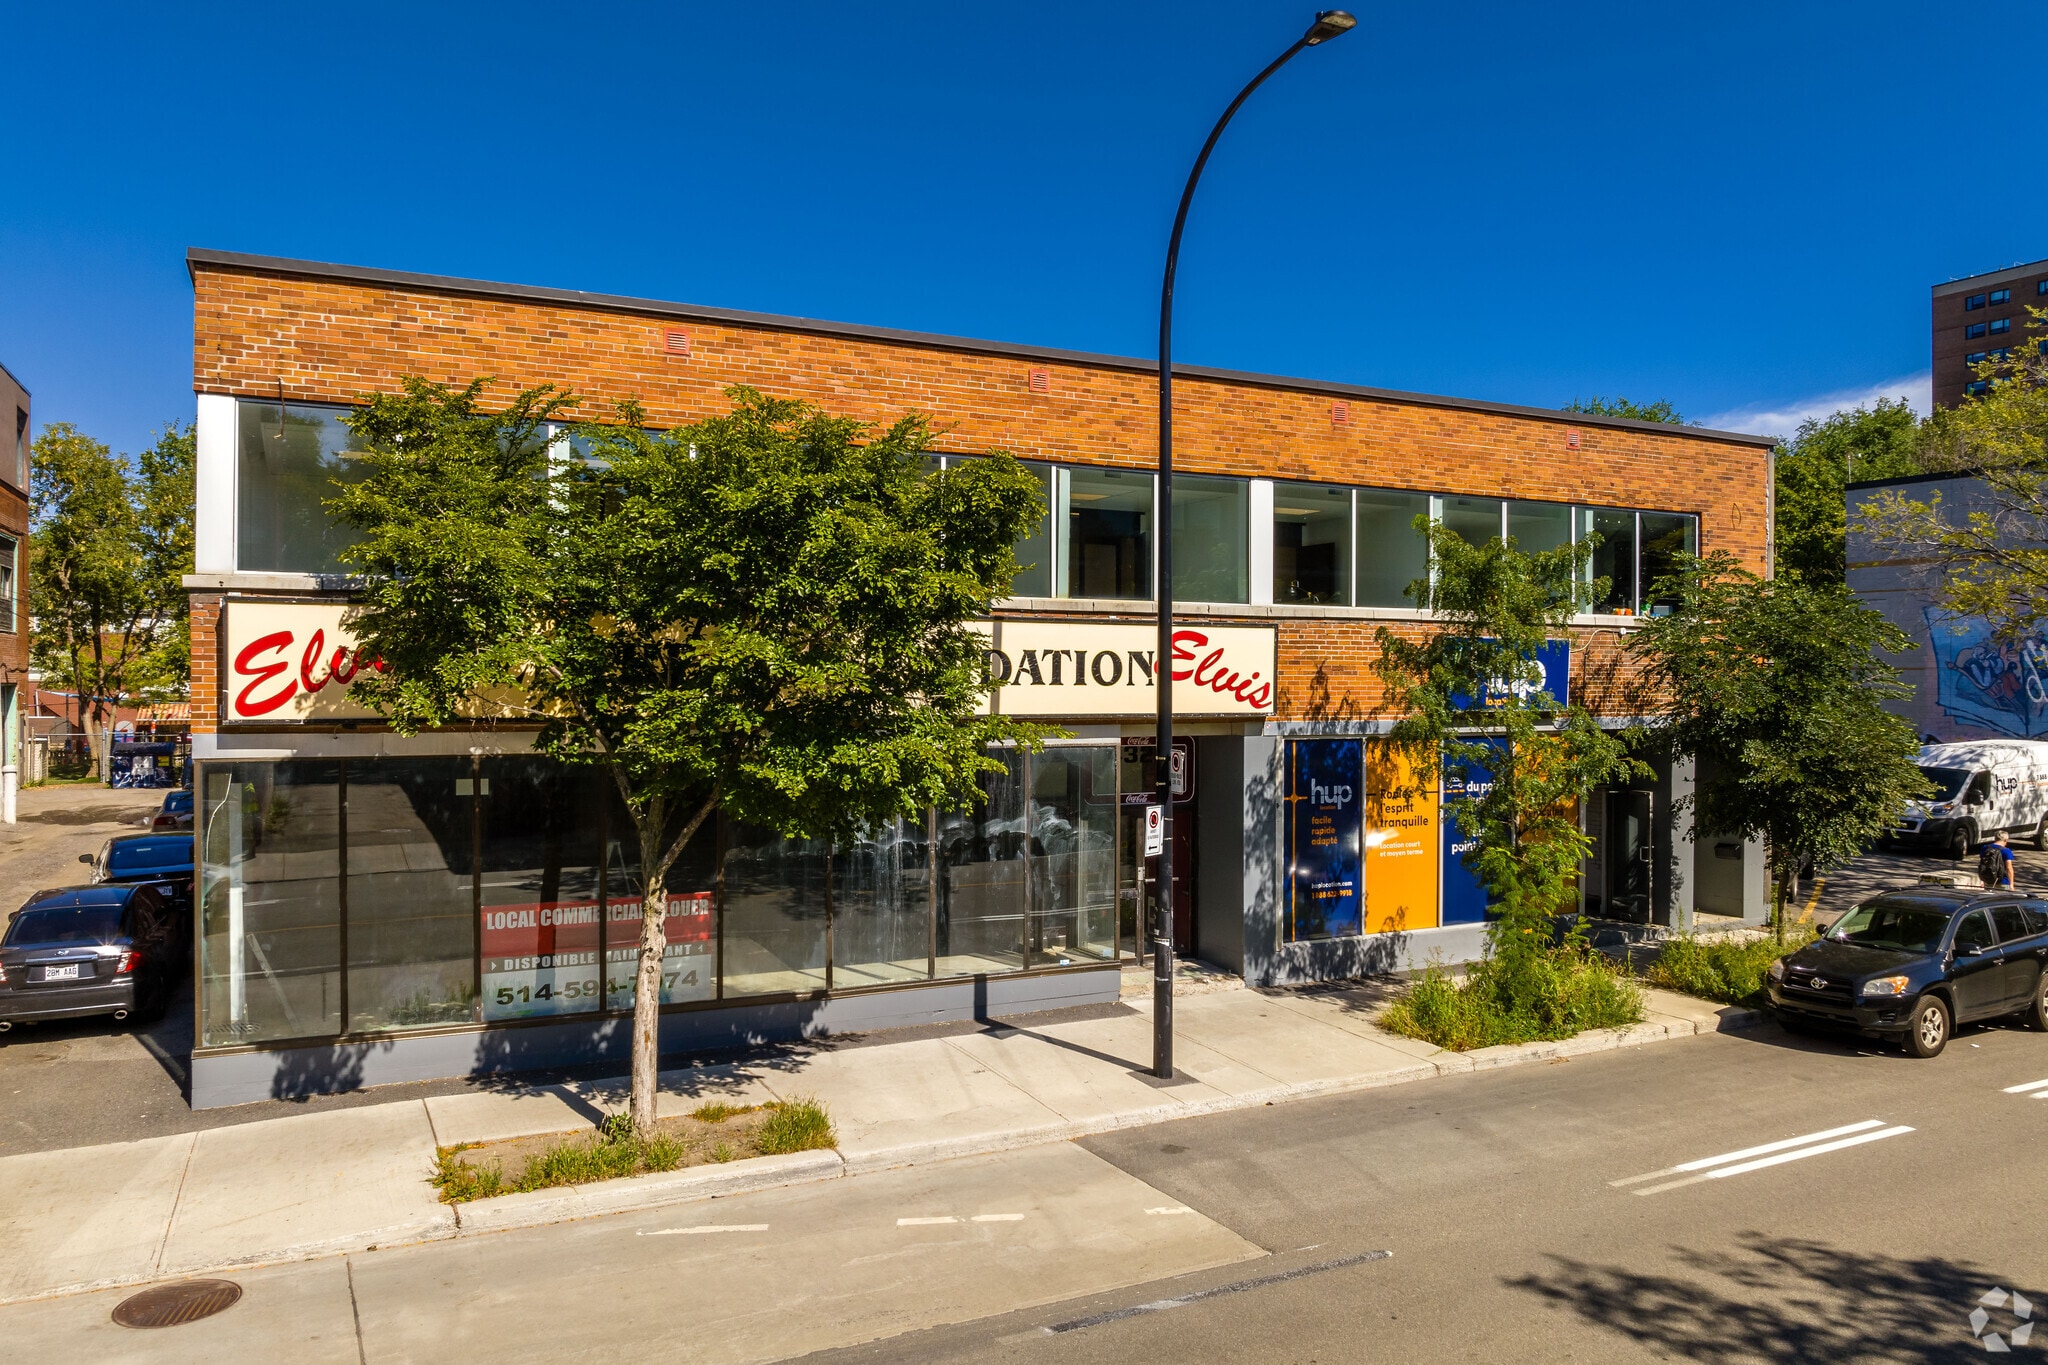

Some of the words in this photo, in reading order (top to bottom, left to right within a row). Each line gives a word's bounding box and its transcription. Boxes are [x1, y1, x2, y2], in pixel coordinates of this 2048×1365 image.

[1154, 630, 1273, 710] Elvis
[1466, 780, 1480, 792] du
[1995, 774, 2018, 794] hup
[1310, 778, 1353, 810] hup
[1380, 802, 1414, 816] l'esprit
[1311, 815, 1333, 825] facile
[1380, 815, 1429, 830] tranquille
[1311, 827, 1336, 837] rapide
[1311, 836, 1339, 847] adapté
[1380, 841, 1405, 850] Location
[1405, 841, 1421, 849] court
[1387, 850, 1406, 859] moyen
[1407, 848, 1424, 856] terme
[487, 909, 537, 930] LOCAL
[504, 952, 595, 971] DISPONIBLE
[605, 944, 692, 962] MAINANT
